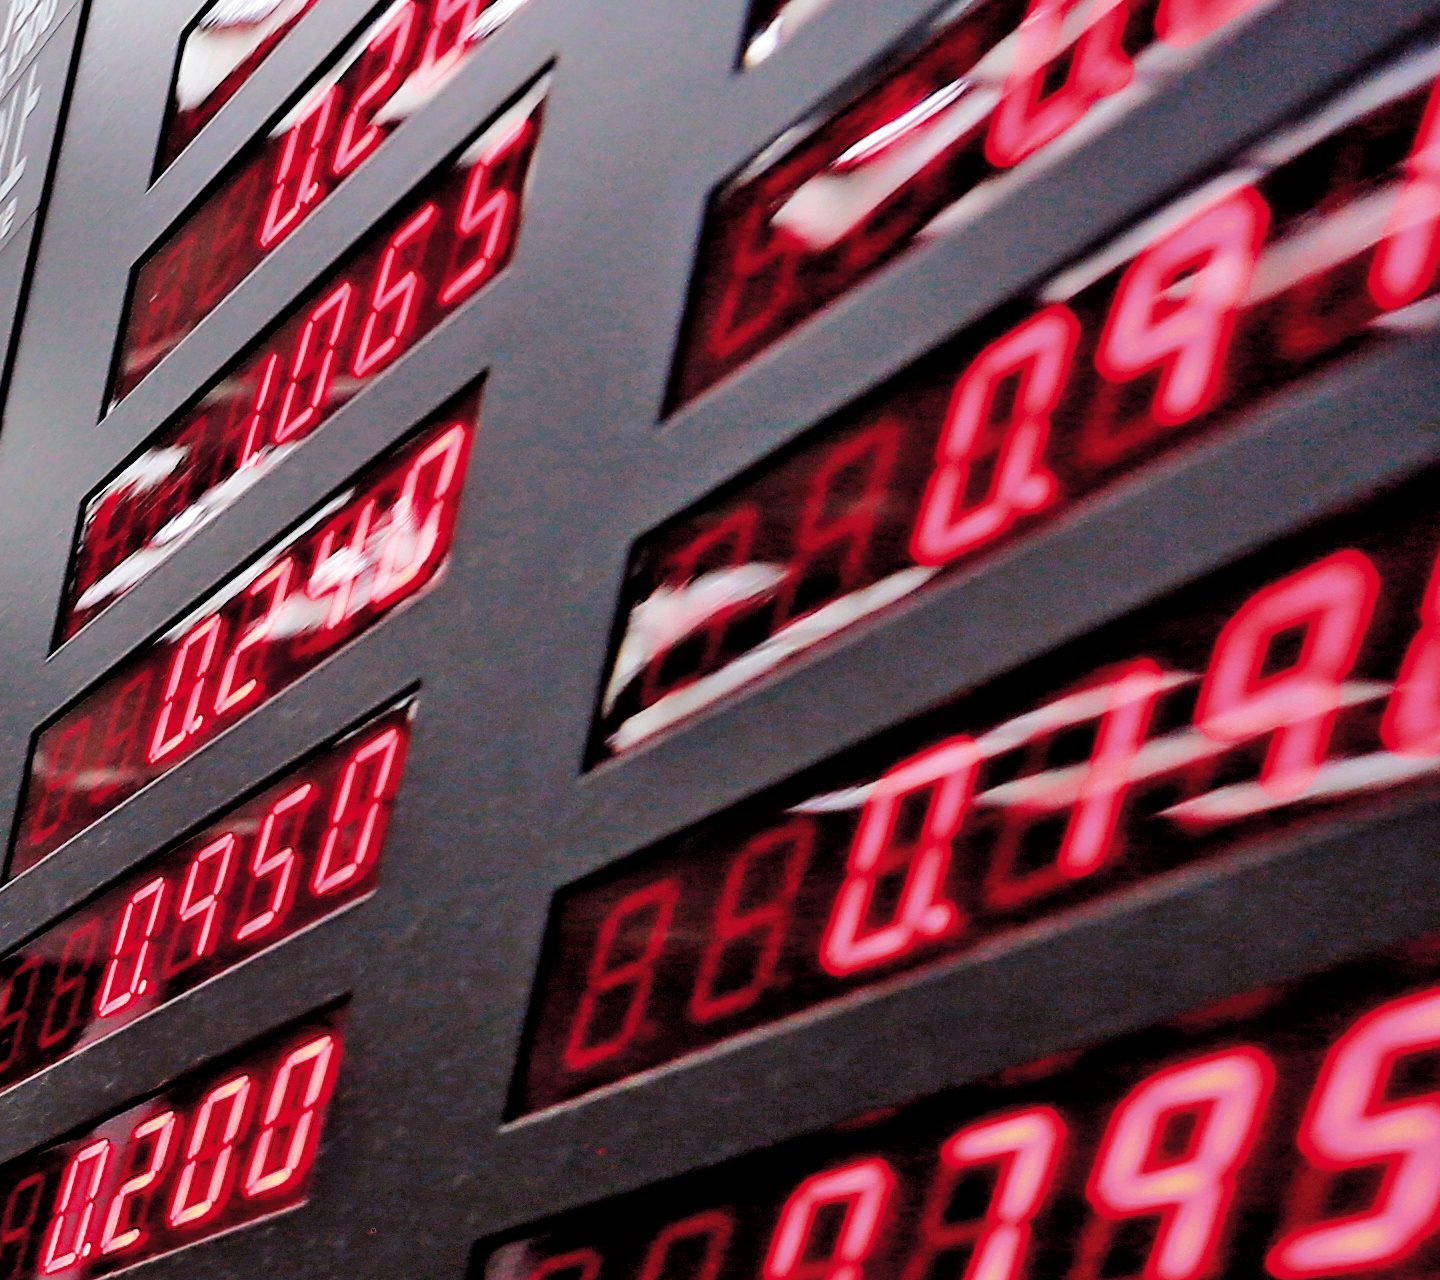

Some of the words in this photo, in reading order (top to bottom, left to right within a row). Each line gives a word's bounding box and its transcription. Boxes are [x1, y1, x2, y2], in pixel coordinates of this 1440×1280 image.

[240, 116, 533, 469] 1.065
[96, 727, 401, 1017] 0.950
[818, 548, 1440, 978] 0.19
[42, 1033, 336, 1275] 0.200
